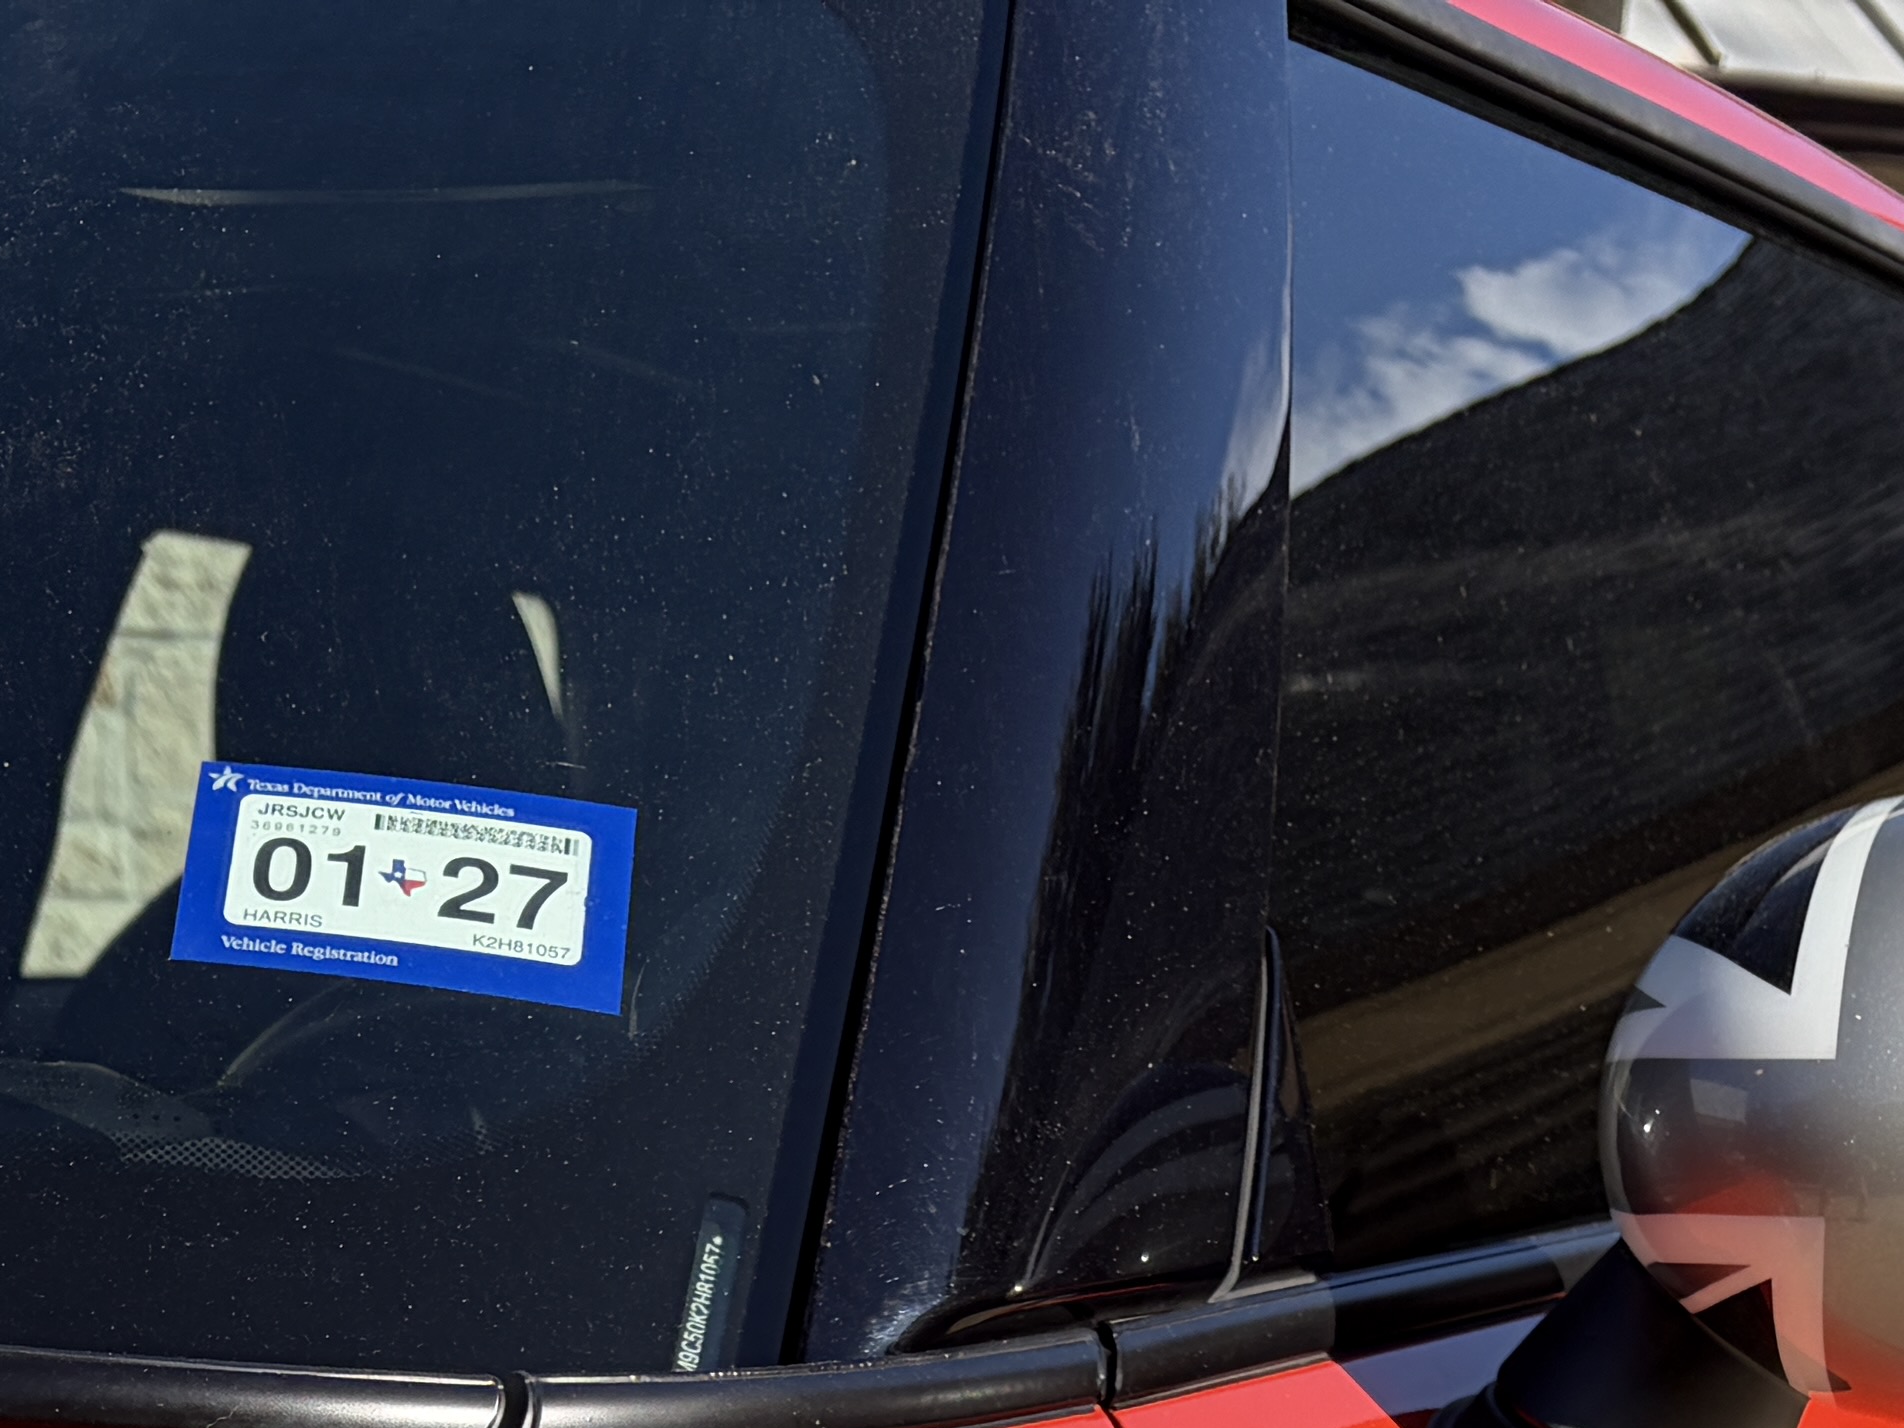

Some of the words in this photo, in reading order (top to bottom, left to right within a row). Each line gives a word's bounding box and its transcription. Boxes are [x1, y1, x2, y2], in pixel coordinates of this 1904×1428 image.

[247, 778, 289, 793] Texas
[293, 782, 383, 803] Department
[386, 791, 405, 805] of
[406, 793, 453, 809] Motor
[454, 799, 515, 817] Vehicles
[257, 803, 345, 821] JRSJCW
[252, 837, 366, 907] 01
[437, 856, 569, 930] 27
[243, 908, 323, 928] HARRIS
[221, 935, 286, 954] Vehicle
[291, 942, 399, 967] Registration
[472, 934, 571, 960] K2H81057
